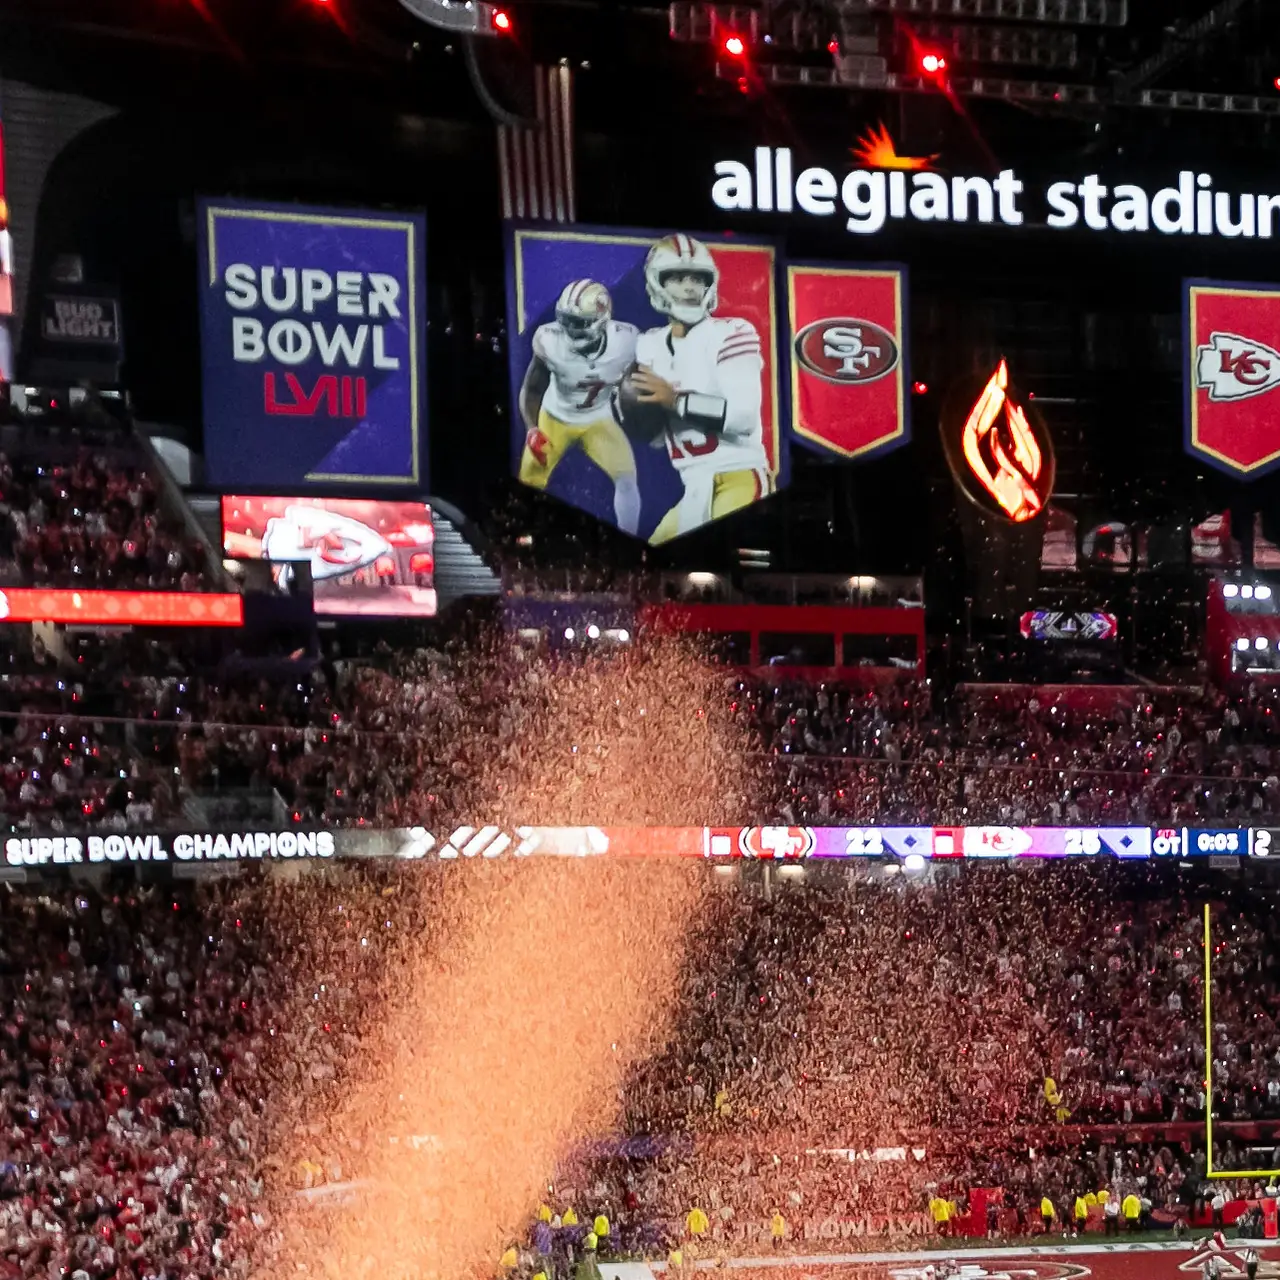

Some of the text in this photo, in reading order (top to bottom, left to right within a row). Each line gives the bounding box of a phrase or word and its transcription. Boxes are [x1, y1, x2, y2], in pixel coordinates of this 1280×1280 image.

[711, 146, 1024, 233] allegiant
[224, 263, 400, 318] SUPER
[47, 317, 114, 338] LIGHT
[55, 300, 103, 321] BUD
[232, 317, 400, 370] BOWL
[1220, 348, 1274, 386] KC
[264, 372, 366, 417] LVIII
[6, 831, 334, 865] SUPER BOWL CHAMPIONS
[846, 829, 883, 854] 22
[1153, 836, 1181, 855] OT
